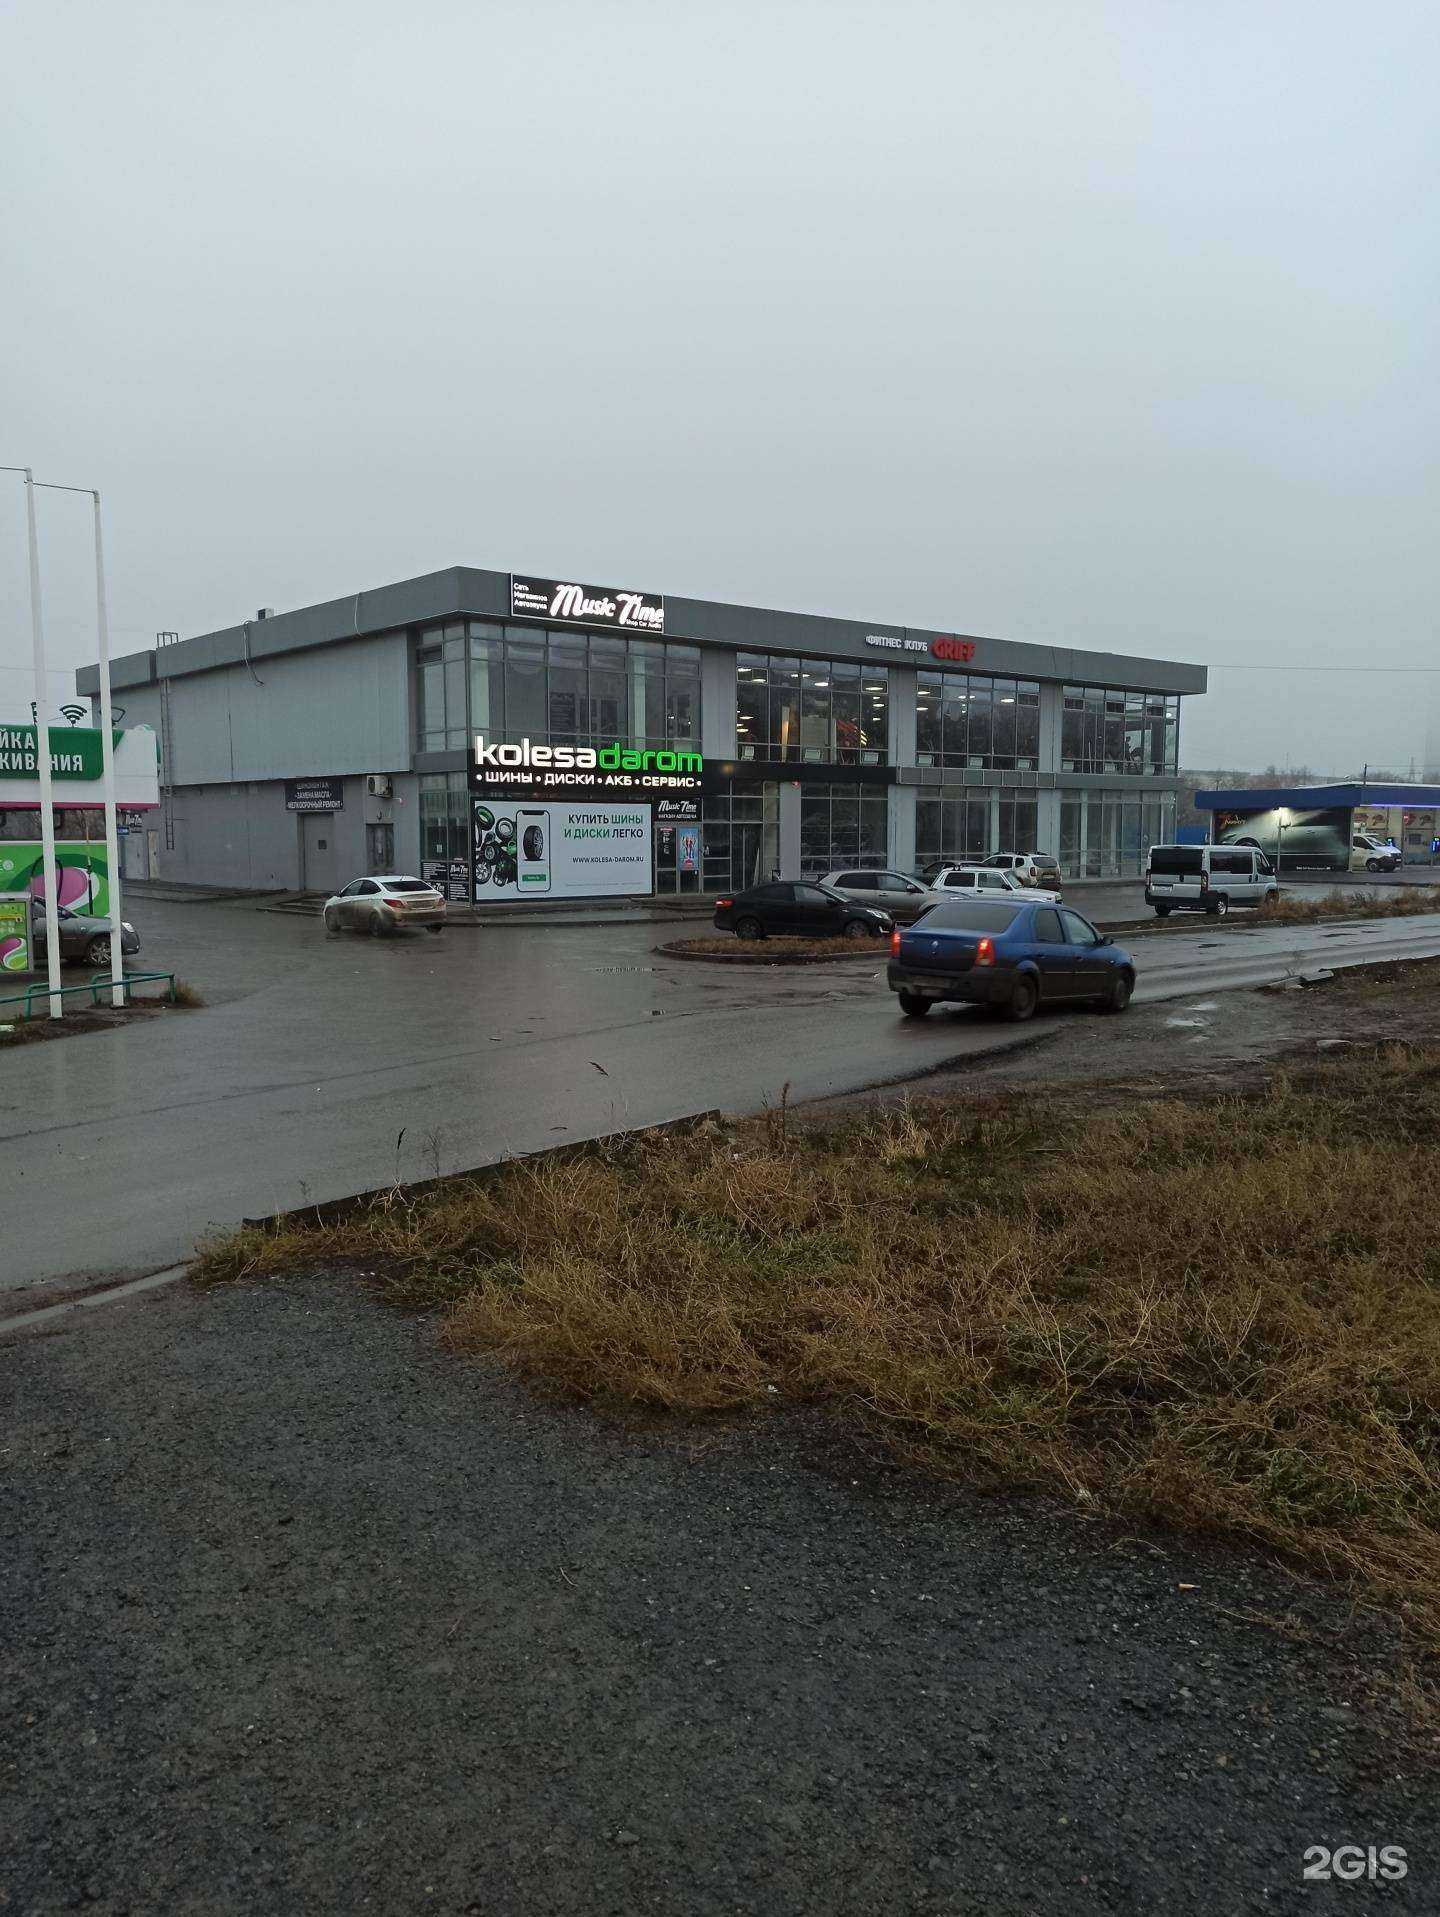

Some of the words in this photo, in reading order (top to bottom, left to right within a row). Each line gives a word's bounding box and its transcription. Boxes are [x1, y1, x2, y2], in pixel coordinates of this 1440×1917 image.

[550, 584, 616, 617] Music
[616, 593, 664, 625] Time
[0, 752, 83, 772] ИВНИЯ
[485, 771, 533, 784] ШИНЫ
[544, 773, 595, 786] ДИСКИ
[605, 775, 632, 786] АКБ
[642, 775, 695, 788] СЕРВИС
[568, 814, 610, 824] КУПИТЬ
[611, 814, 643, 824] ШИНЫ
[564, 828, 572, 838] И
[573, 828, 610, 840] ДИСКИ
[611, 828, 644, 838] ЛЕГКО
